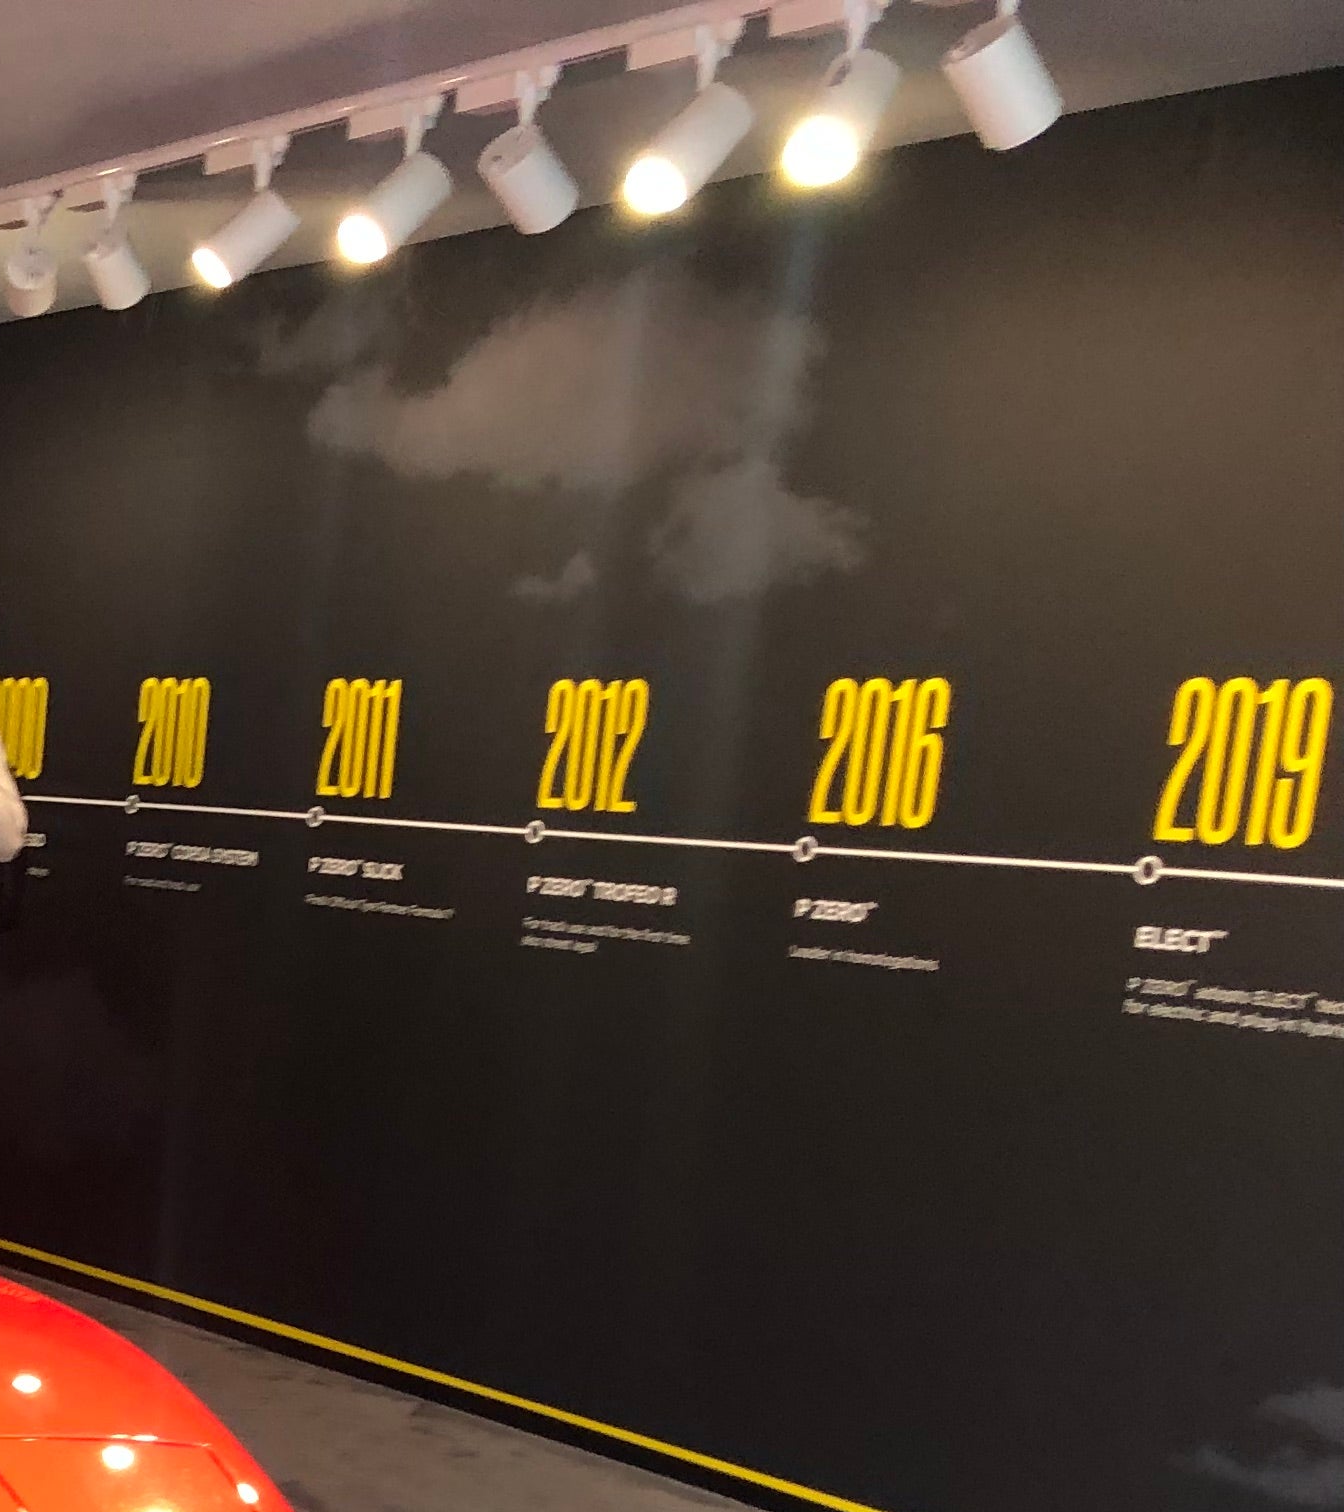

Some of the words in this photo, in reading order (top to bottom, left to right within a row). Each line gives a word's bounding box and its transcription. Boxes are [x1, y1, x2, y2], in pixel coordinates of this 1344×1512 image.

[132, 677, 211, 788] 2010
[316, 677, 403, 799] 2011
[537, 678, 651, 813] 2012
[808, 677, 952, 829] 2016
[1152, 676, 1335, 849] 2019
